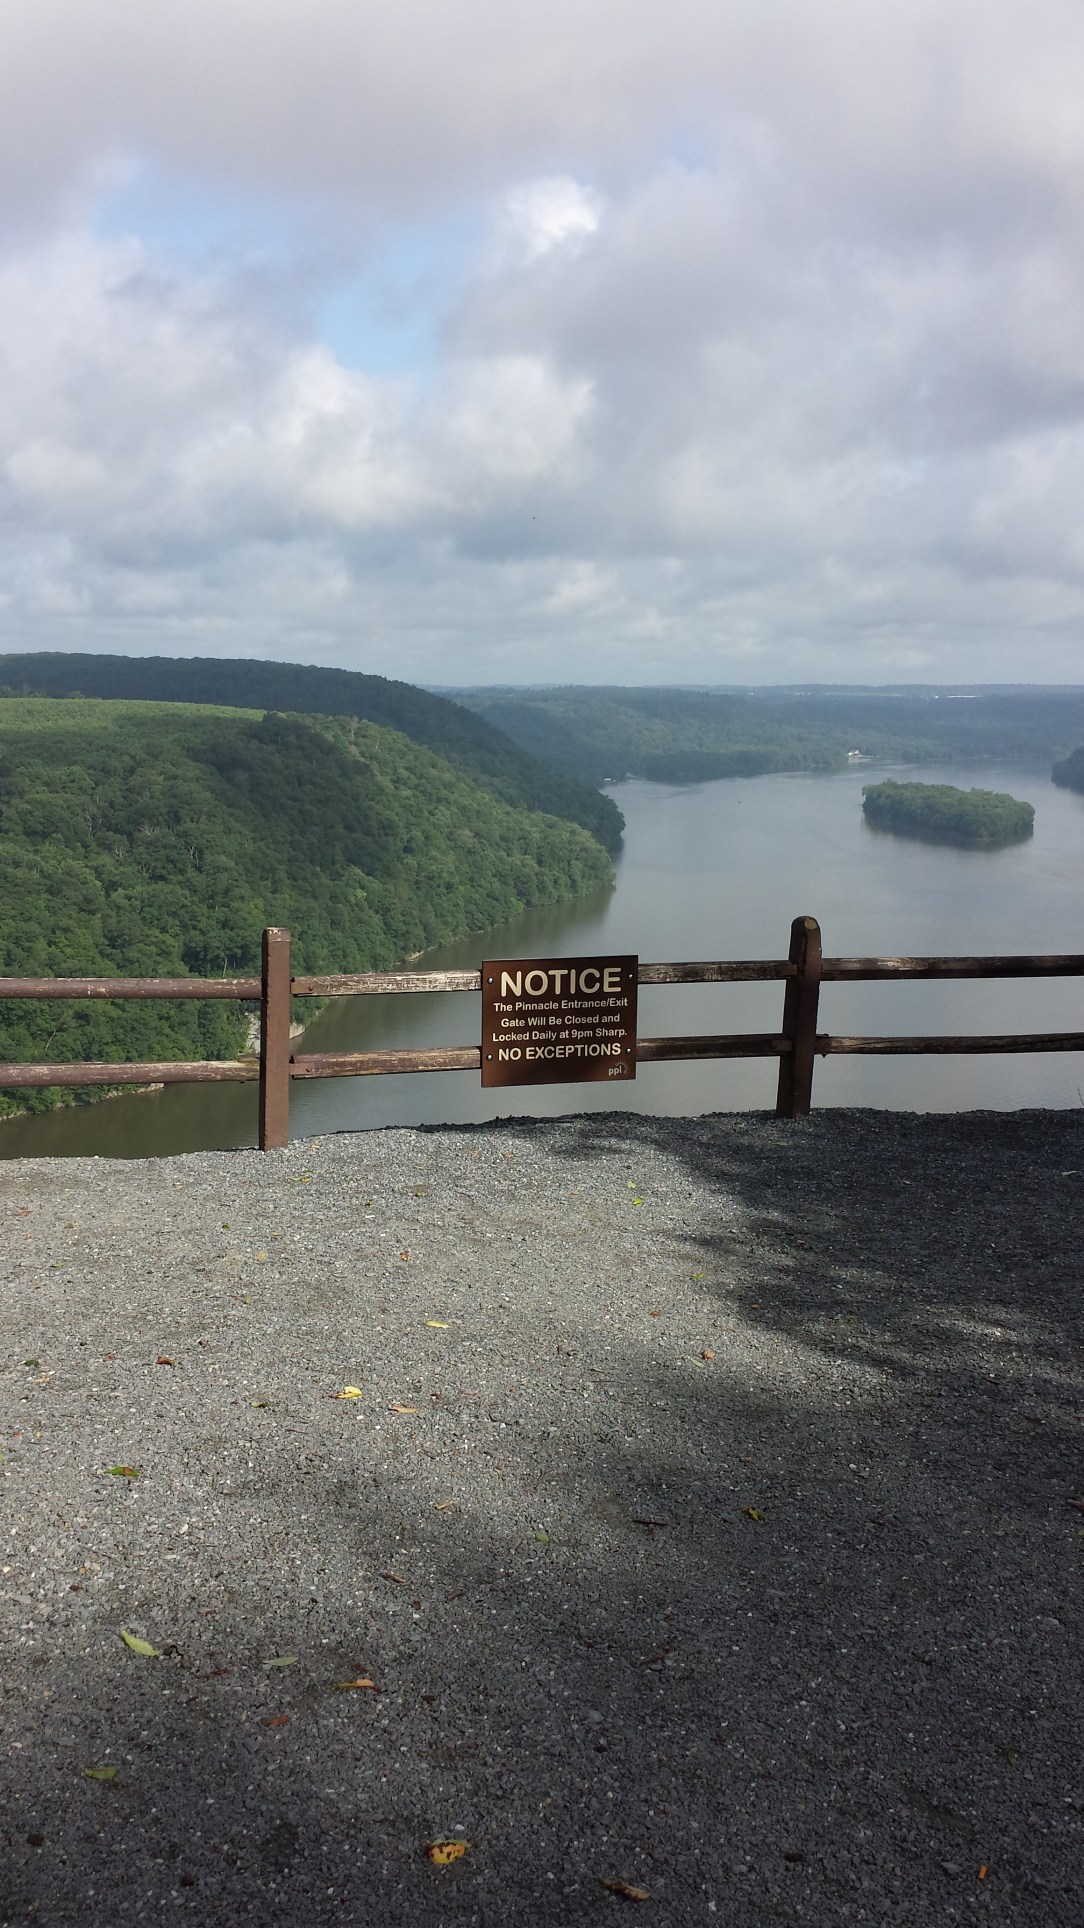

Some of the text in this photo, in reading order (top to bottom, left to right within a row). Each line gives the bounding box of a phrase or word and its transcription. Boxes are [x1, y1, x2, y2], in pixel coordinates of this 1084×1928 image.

[500, 967, 622, 998] NOTICE
[493, 997, 628, 1012] The Pinnacle Entrance/Exit
[500, 1014, 620, 1028] Gate Will Be Closed and
[492, 1028, 628, 1042] Locked Daily at 9pm Sharp.
[498, 1043, 622, 1061] NO EXCEPTIONS
[608, 1065, 622, 1076] ppl
